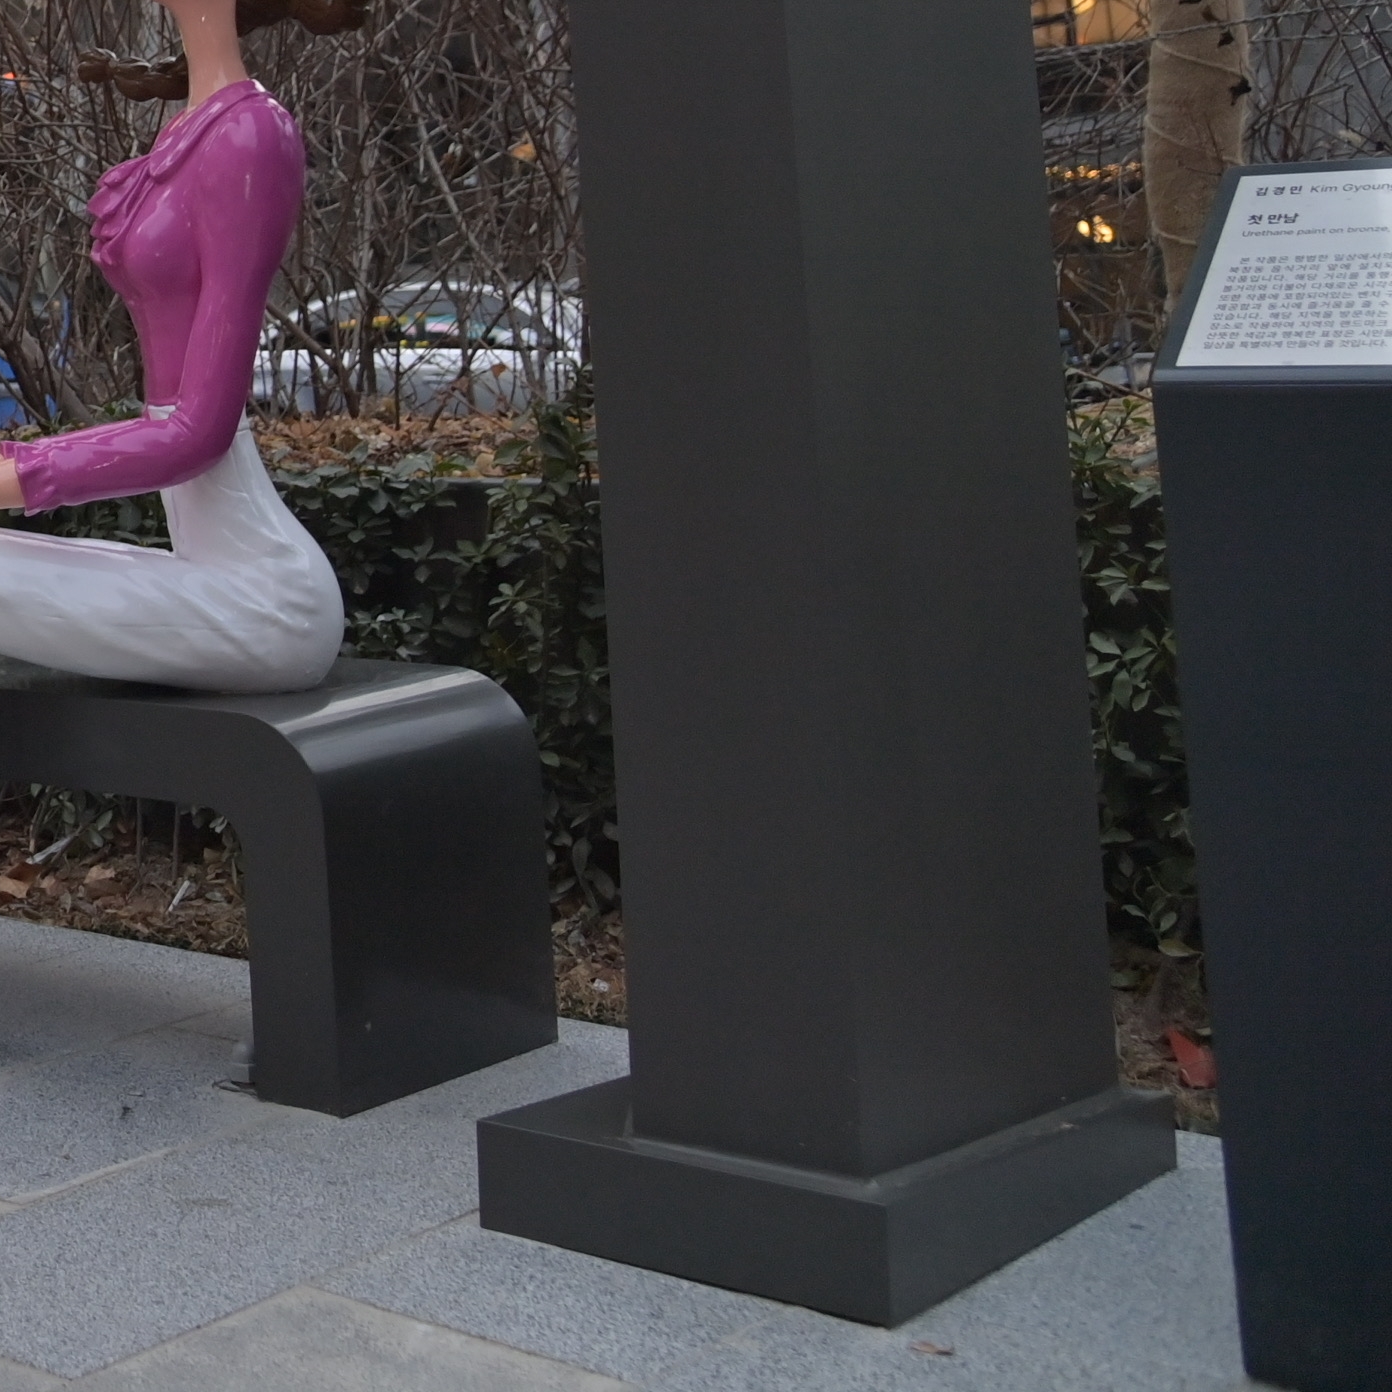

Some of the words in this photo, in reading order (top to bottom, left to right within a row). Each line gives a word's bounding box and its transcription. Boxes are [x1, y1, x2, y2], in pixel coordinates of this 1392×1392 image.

[1310, 184, 1338, 193] Kim
[1248, 214, 1263, 225] 첫
[1268, 213, 1299, 224] 만남
[1297, 228, 1326, 236] paint
